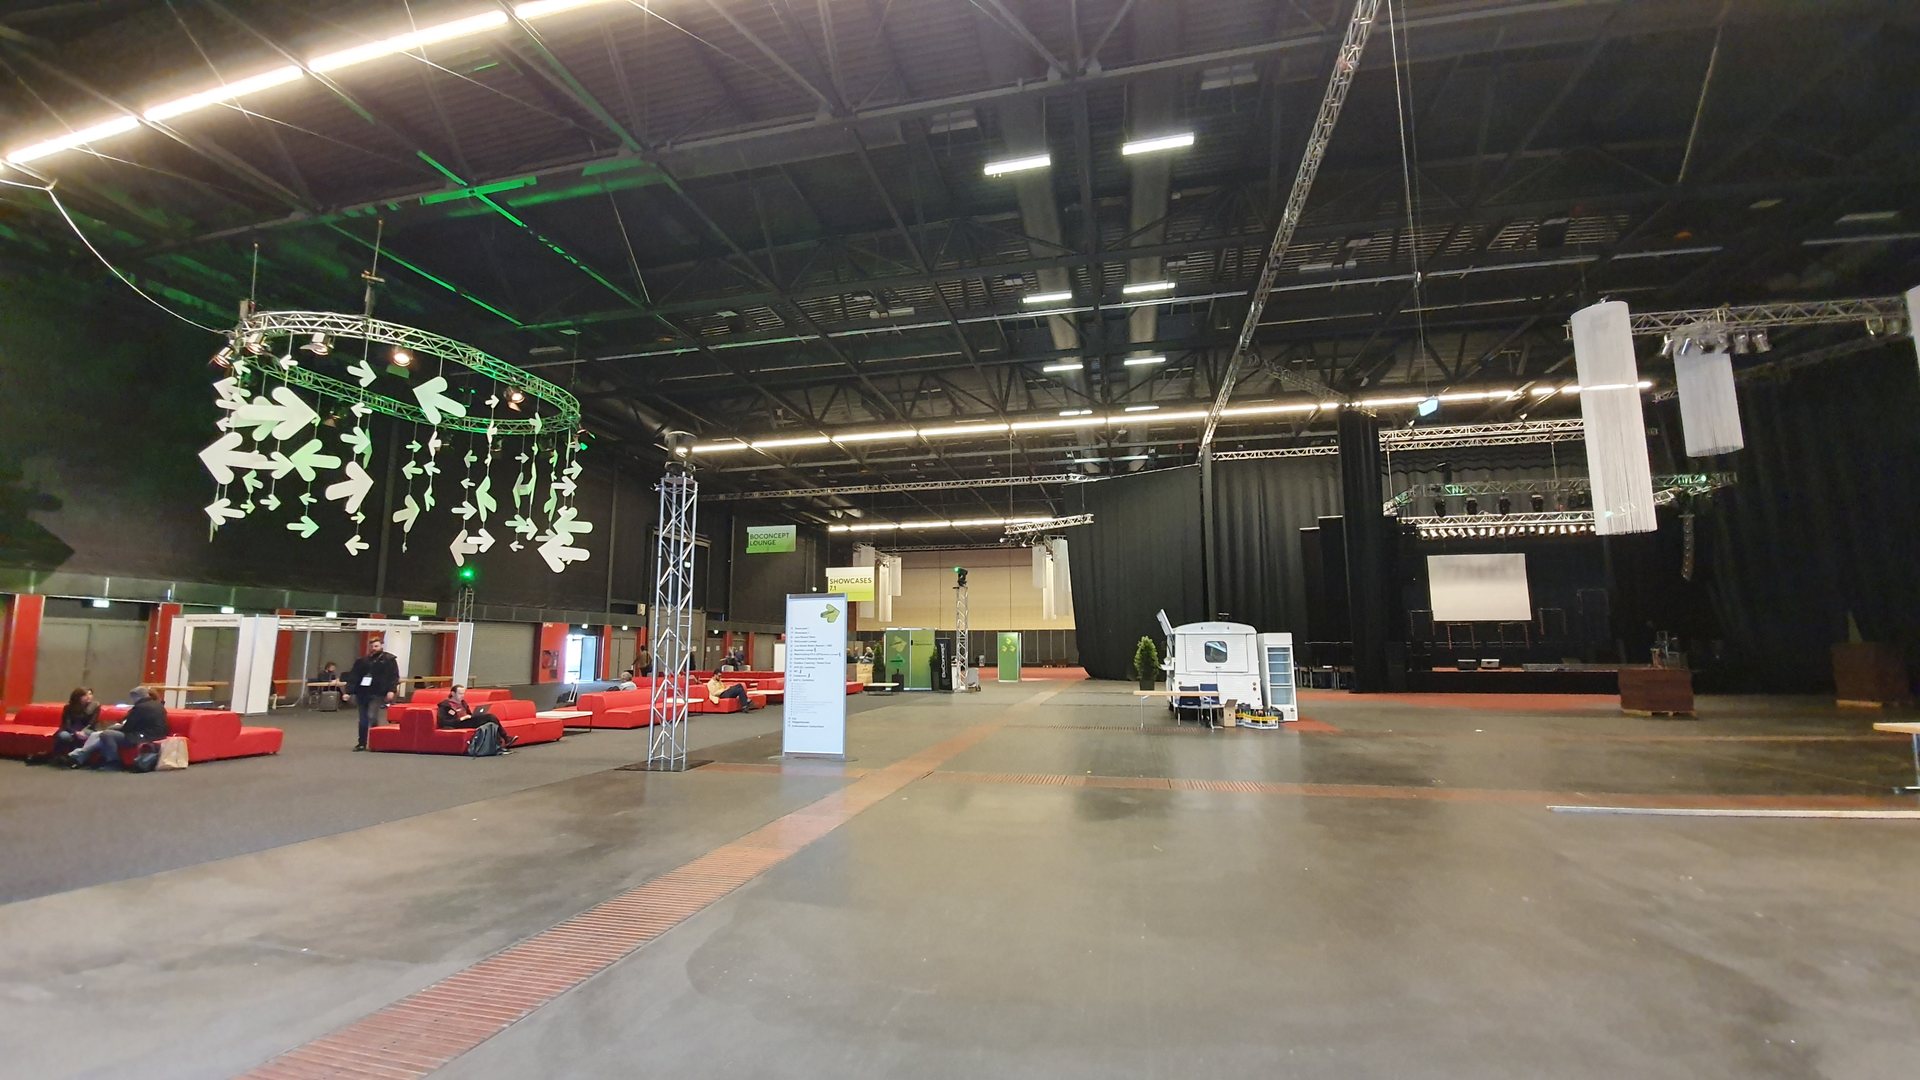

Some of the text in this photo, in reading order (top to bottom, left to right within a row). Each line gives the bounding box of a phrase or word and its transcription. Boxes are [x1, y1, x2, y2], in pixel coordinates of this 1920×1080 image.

[749, 532, 790, 540] BOCONCEPT
[749, 539, 776, 547] LOUNGE
[829, 577, 872, 585] SHOWCASES
